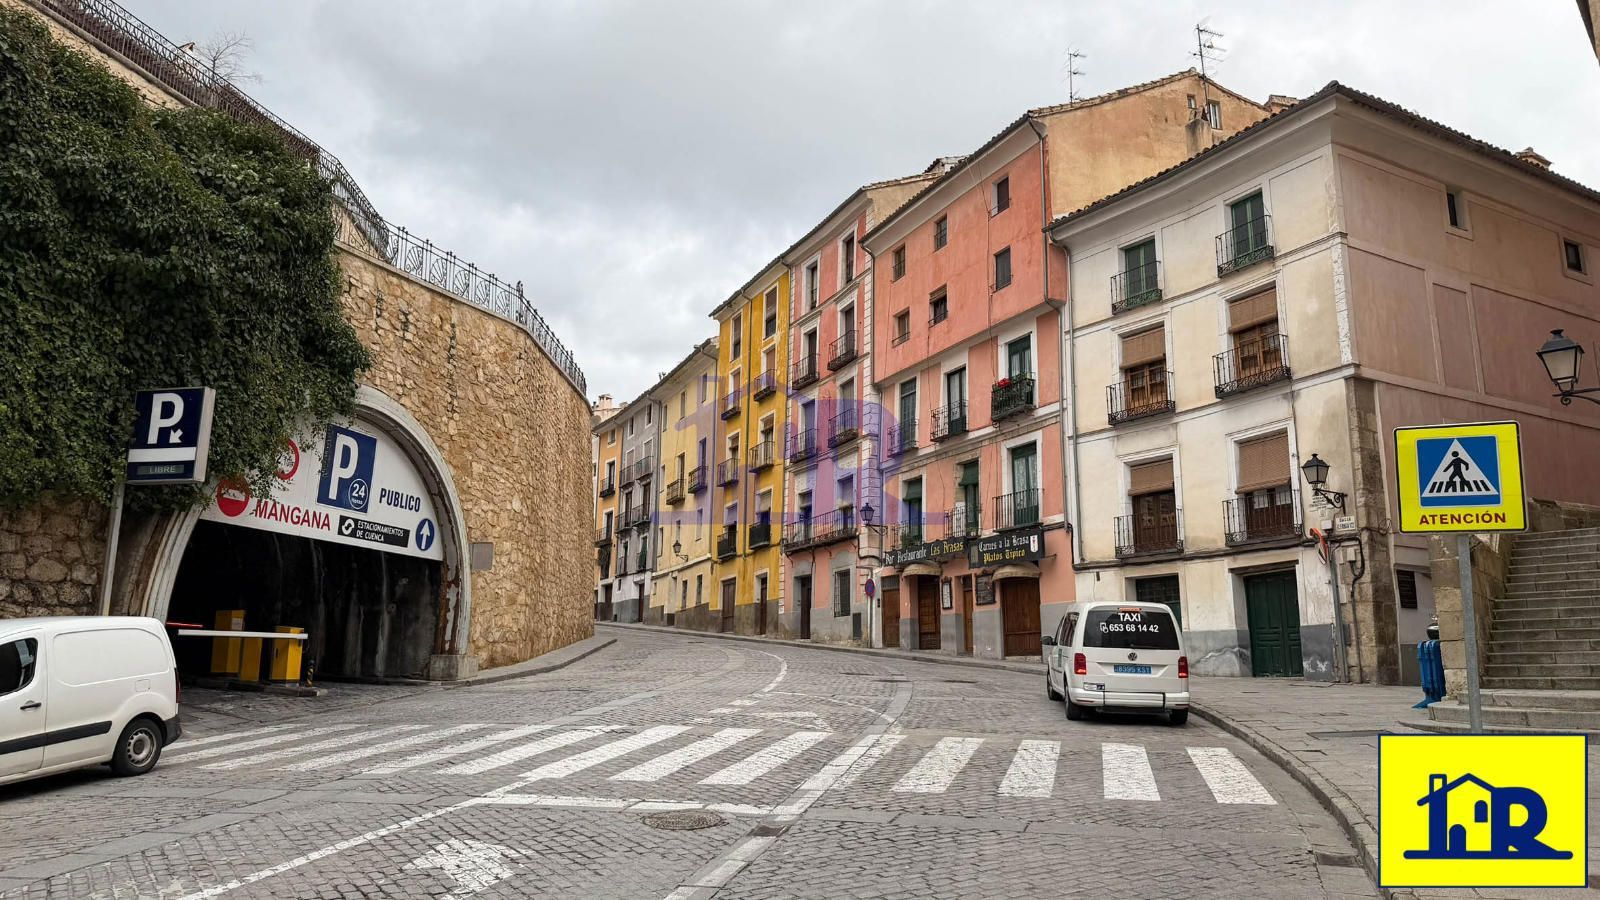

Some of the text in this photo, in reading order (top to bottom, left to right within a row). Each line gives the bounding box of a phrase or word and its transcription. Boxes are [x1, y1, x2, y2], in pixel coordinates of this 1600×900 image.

[147, 392, 185, 445] P
[149, 465, 176, 474] LIBRE
[328, 432, 359, 500] P
[351, 483, 366, 498] 24
[379, 487, 421, 513] PUBLICO
[254, 499, 331, 531] MANGANA
[1419, 510, 1507, 525] ATENCIÓN
[356, 530, 384, 542] DE CUENCA
[357, 520, 404, 537] ESTACIONAMIENTOS
[998, 540, 1003, 548] a
[1004, 537, 1010, 548] la
[1012, 535, 1030, 546] Brasa
[885, 541, 964, 565] Bar Restaurante Las Brasas
[1117, 612, 1141, 622] TAXI
[1109, 623, 1159, 633] 653 68 14 42
